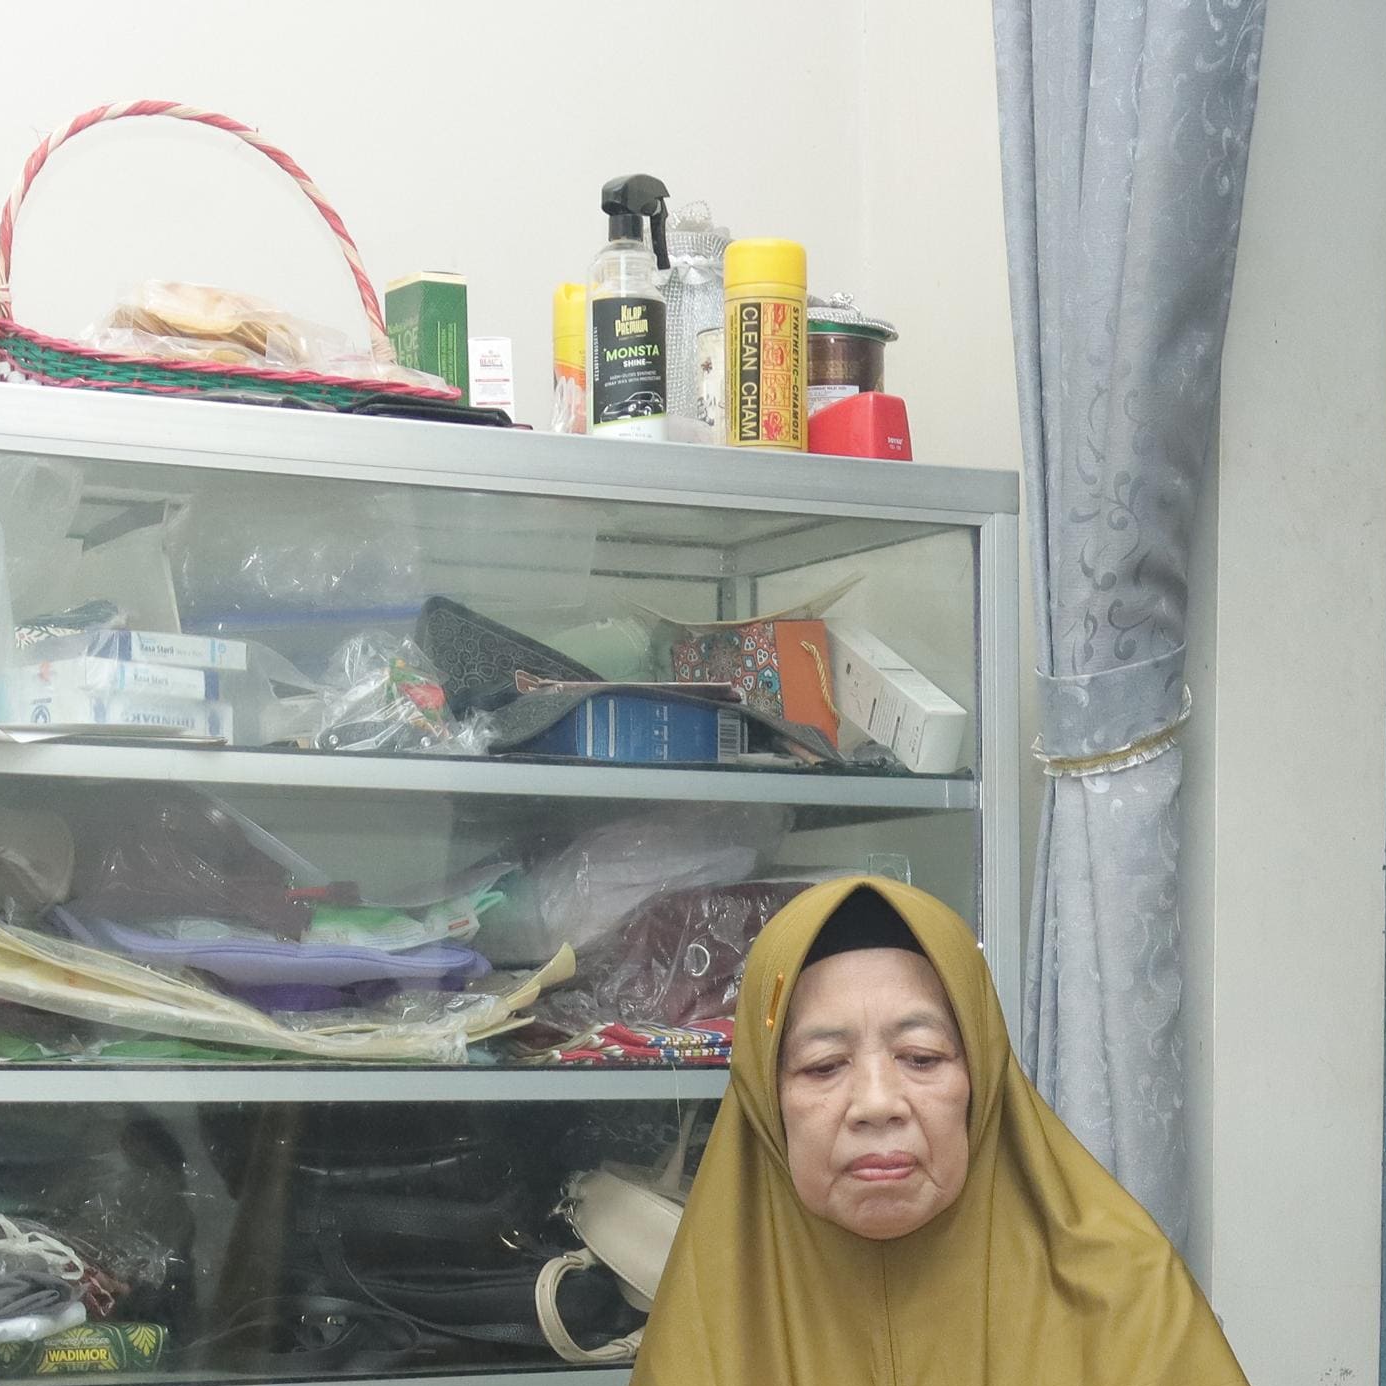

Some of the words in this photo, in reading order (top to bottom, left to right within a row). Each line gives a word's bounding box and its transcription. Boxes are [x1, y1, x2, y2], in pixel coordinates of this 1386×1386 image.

[605, 344, 661, 362] MONSTA
[741, 306, 758, 370] CLEAN
[741, 382, 758, 438] CHAM
[48, 1348, 108, 1363] WADIMOR
